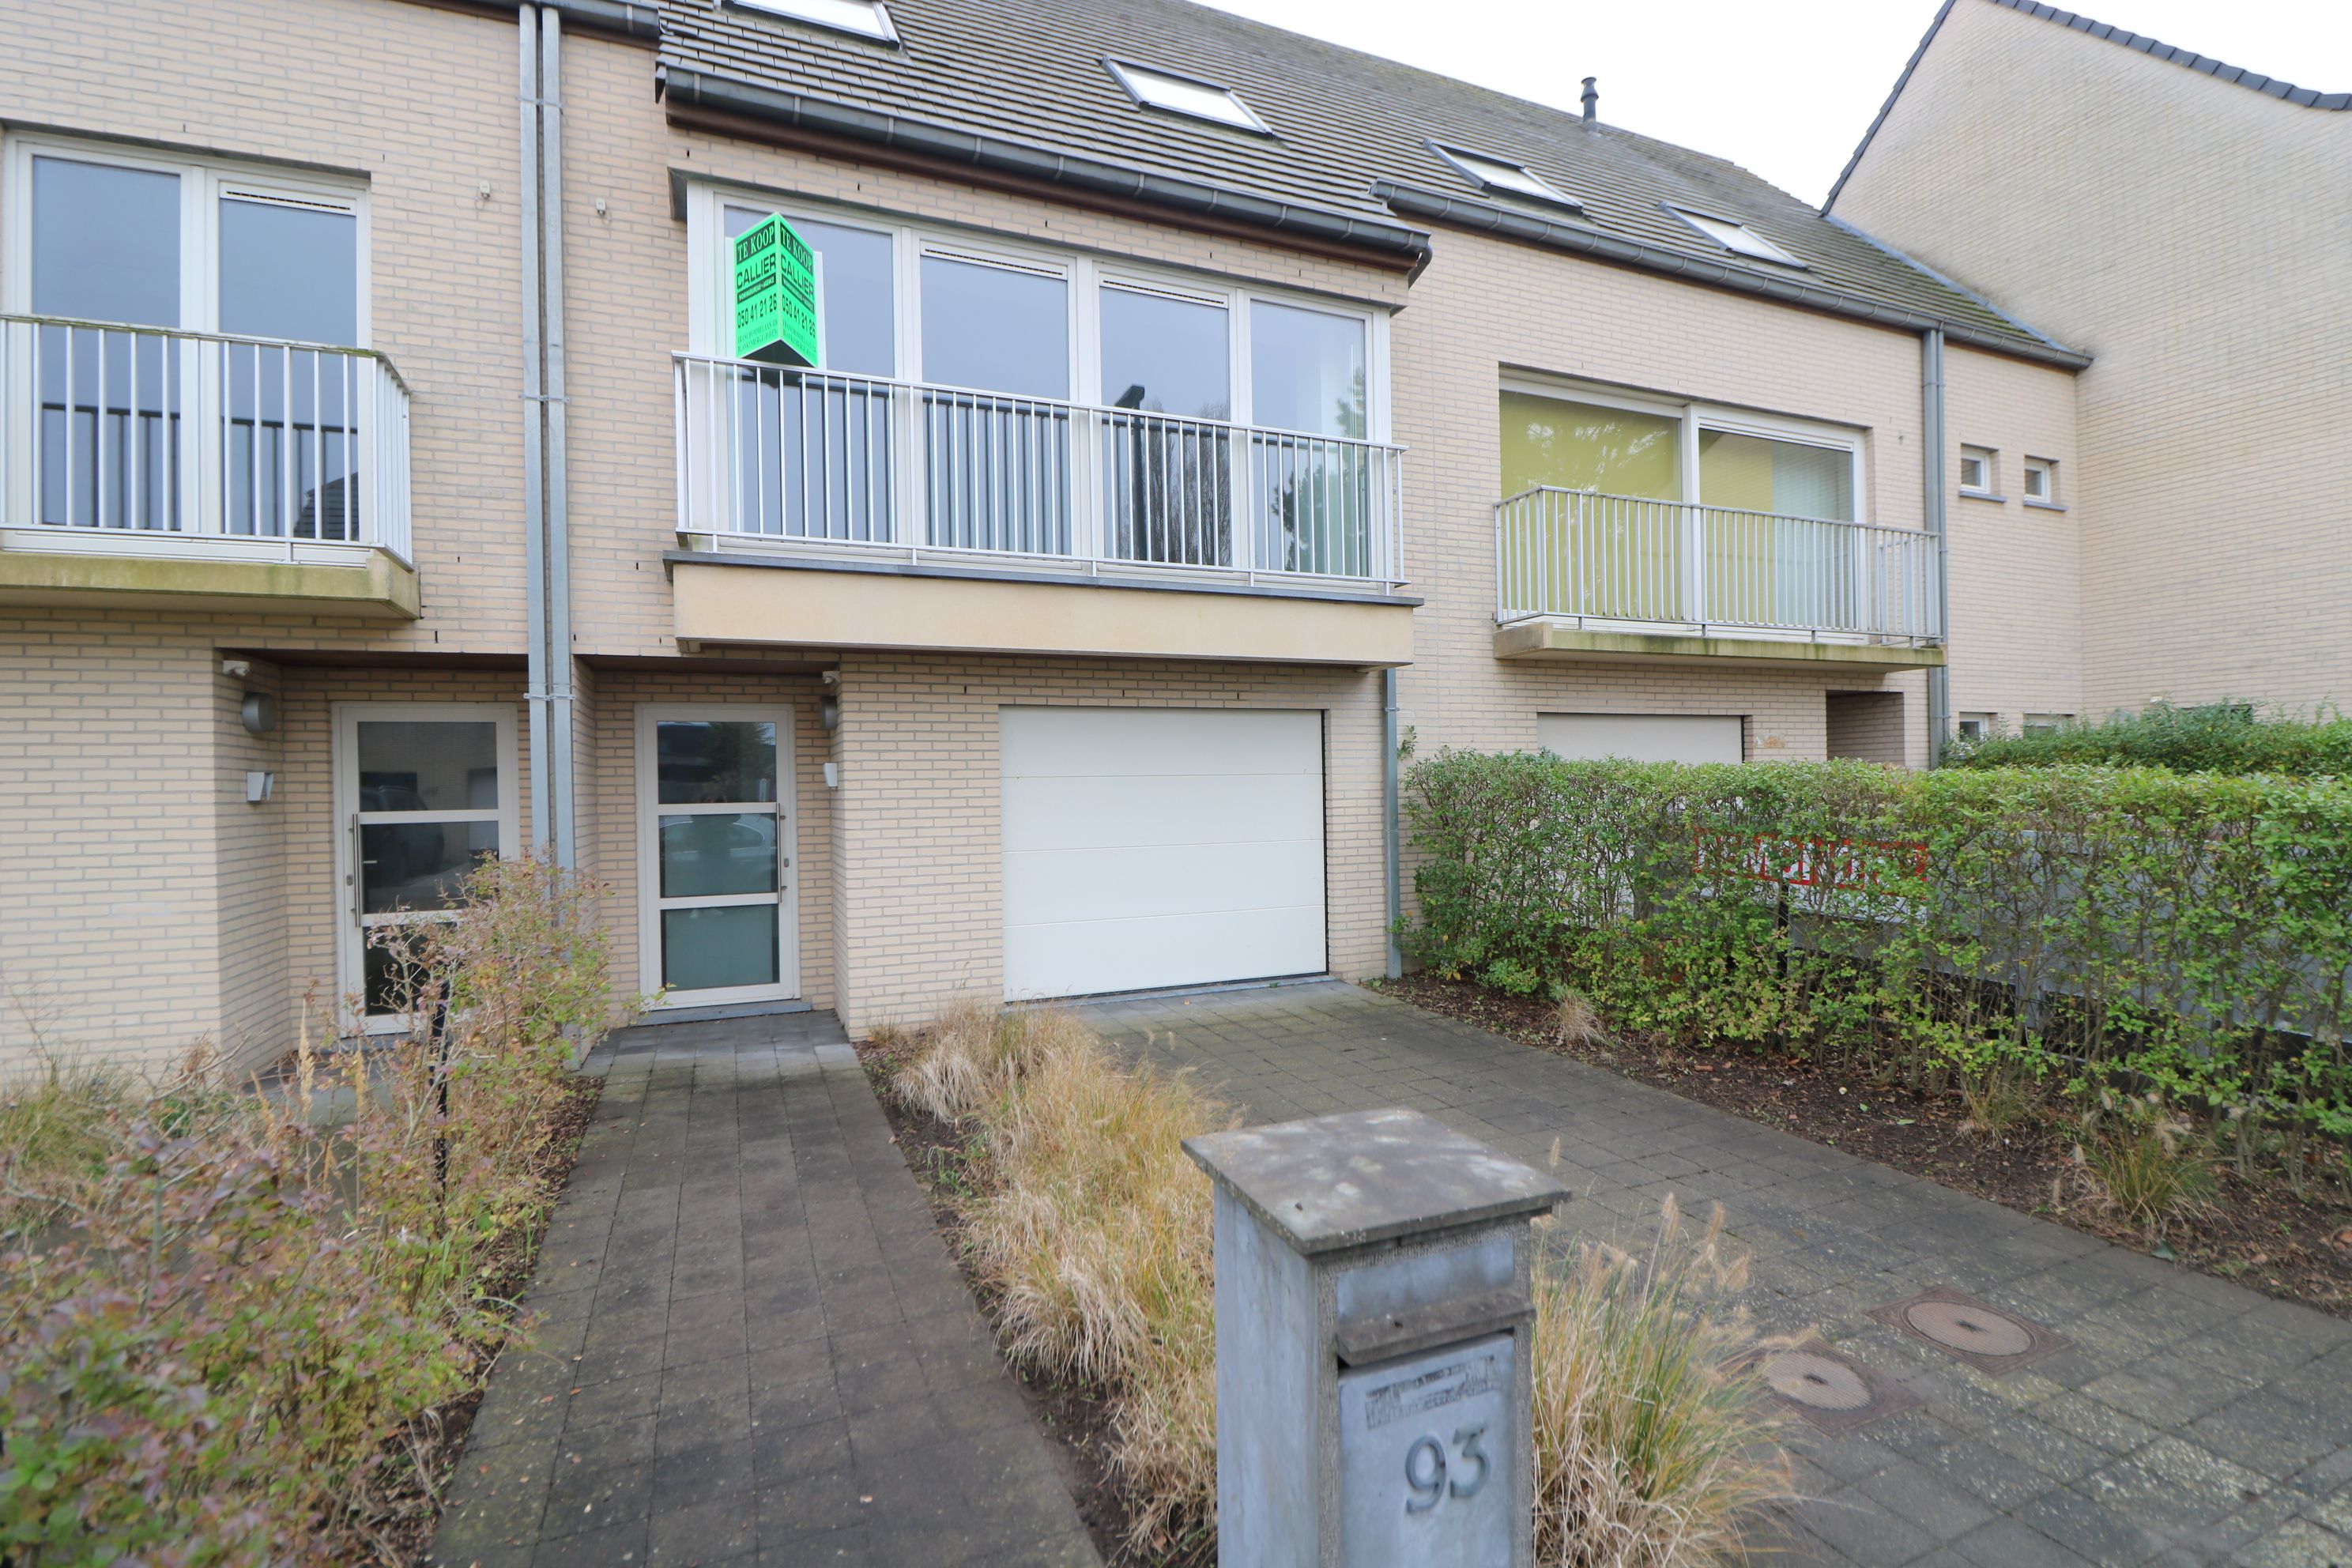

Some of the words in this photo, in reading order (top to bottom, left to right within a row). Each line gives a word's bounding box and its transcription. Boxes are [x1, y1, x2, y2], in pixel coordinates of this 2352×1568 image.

[737, 241, 748, 262] TE
[750, 224, 774, 254] KOOP
[781, 226, 791, 252] TE
[792, 239, 812, 274] KOOP
[737, 252, 776, 290] CALLIER
[780, 253, 814, 300] CALLIER
[737, 307, 748, 329] 050
[750, 303, 758, 323] 41
[760, 298, 767, 318] 21
[769, 292, 777, 313] 26
[782, 294, 792, 317] 050
[793, 304, 800, 325] 41
[801, 312, 808, 333] 21
[808, 318, 816, 339] 26
[1405, 1425, 1491, 1513] 93
